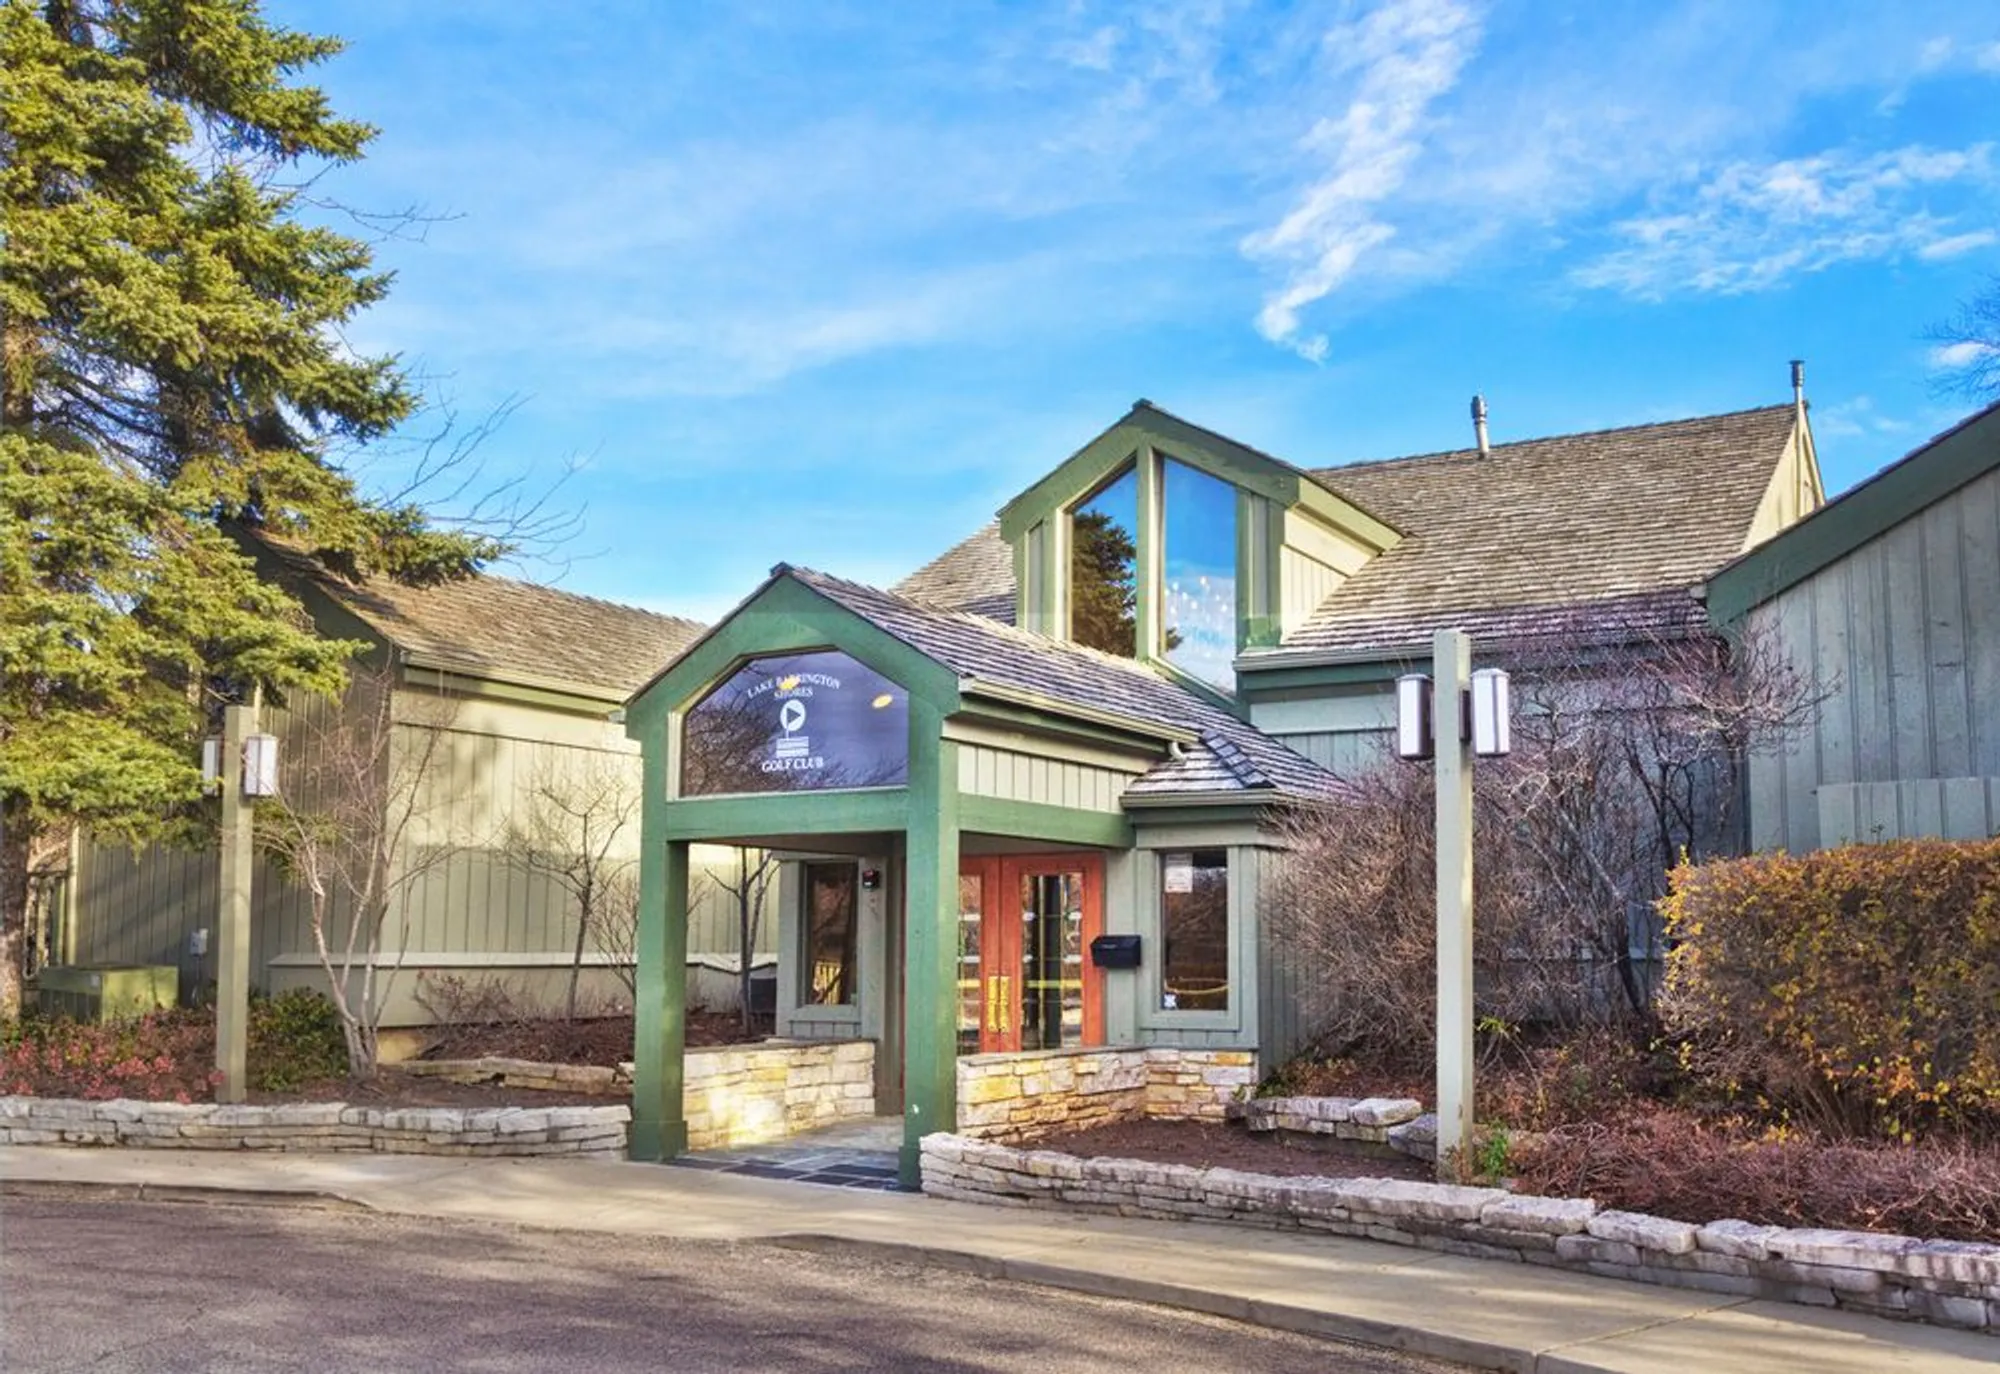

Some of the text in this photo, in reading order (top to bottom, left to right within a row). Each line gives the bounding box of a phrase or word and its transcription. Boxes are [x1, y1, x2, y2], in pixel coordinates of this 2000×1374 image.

[747, 673, 841, 699] LAKE BRINGTON
[762, 756, 824, 773] GOLF CLUB
